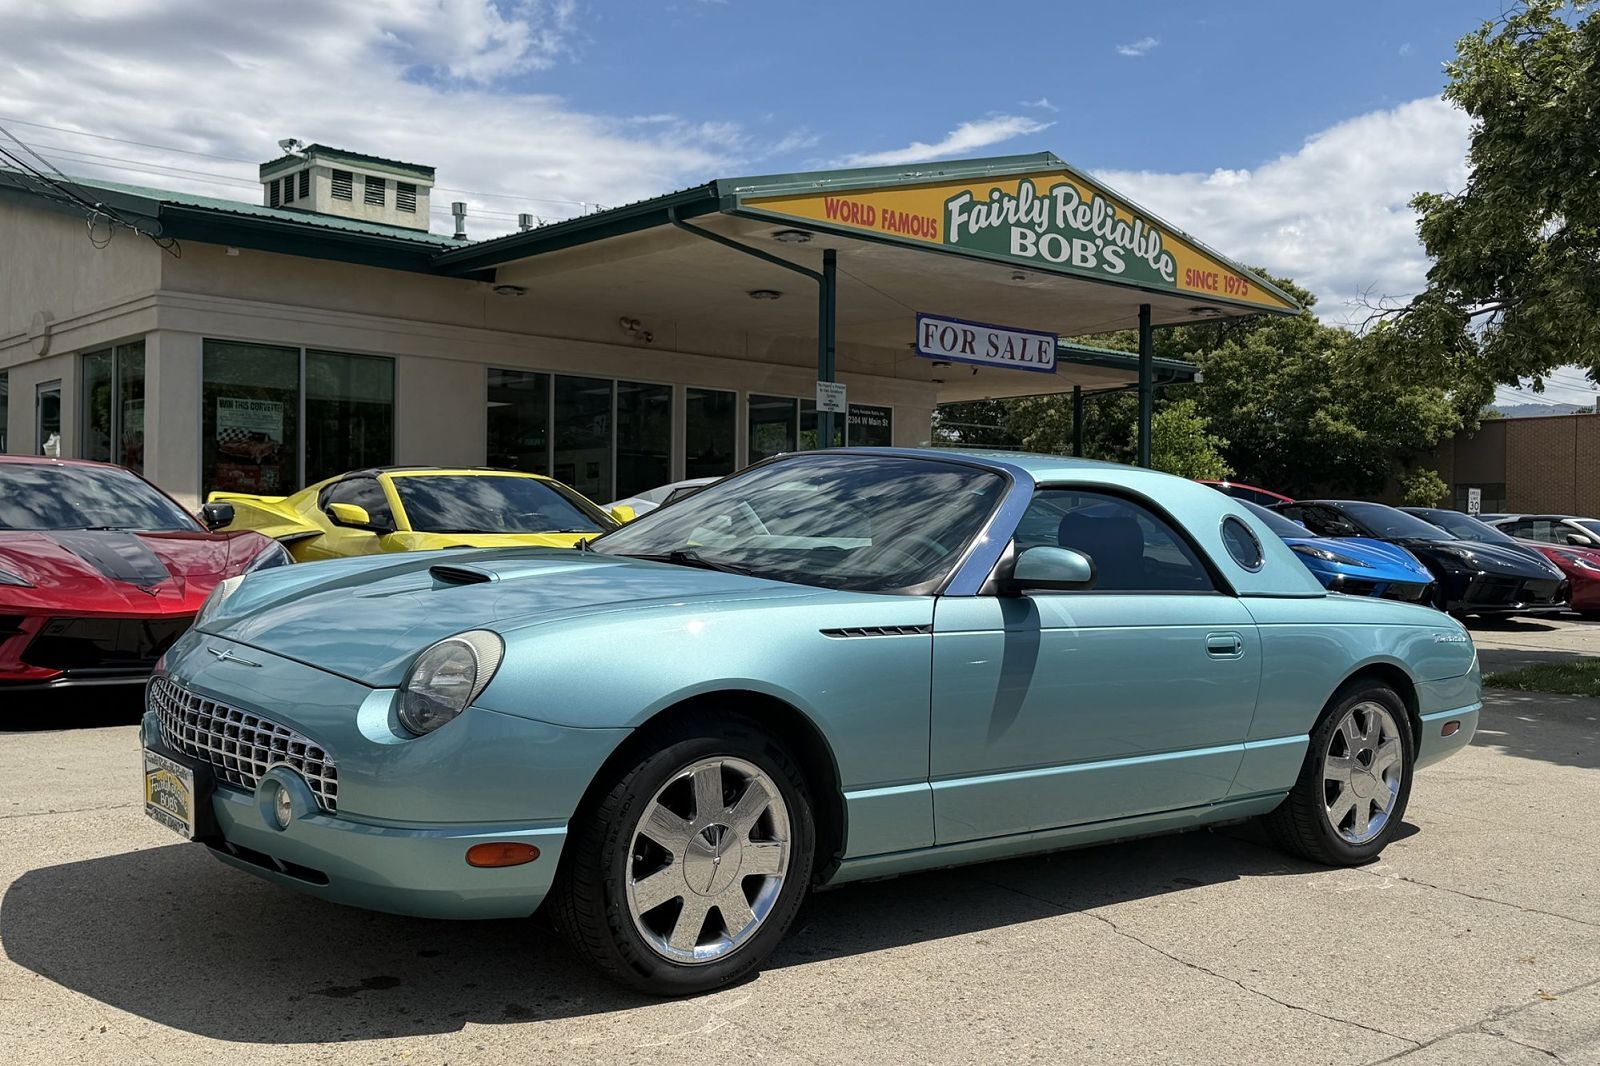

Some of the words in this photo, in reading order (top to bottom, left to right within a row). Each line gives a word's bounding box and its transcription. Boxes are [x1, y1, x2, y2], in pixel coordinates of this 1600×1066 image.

[824, 196, 876, 227] WORLD
[881, 208, 938, 239] FAMOUS
[948, 182, 1050, 243] Fairly
[1053, 185, 1175, 282] Reliable
[1010, 226, 1126, 274] BOB'S
[1185, 267, 1219, 291] SINCE
[1223, 274, 1249, 297] 1975
[923, 322, 976, 355] FOR
[986, 332, 1051, 364] SALE
[219, 399, 234, 409] WIN
[235, 400, 249, 410] THIS
[848, 416, 861, 424] 2304
[862, 416, 868, 425] W
[868, 417, 882, 427] Main
[1470, 501, 1479, 510] 30
[160, 792, 178, 813] BOB'S
